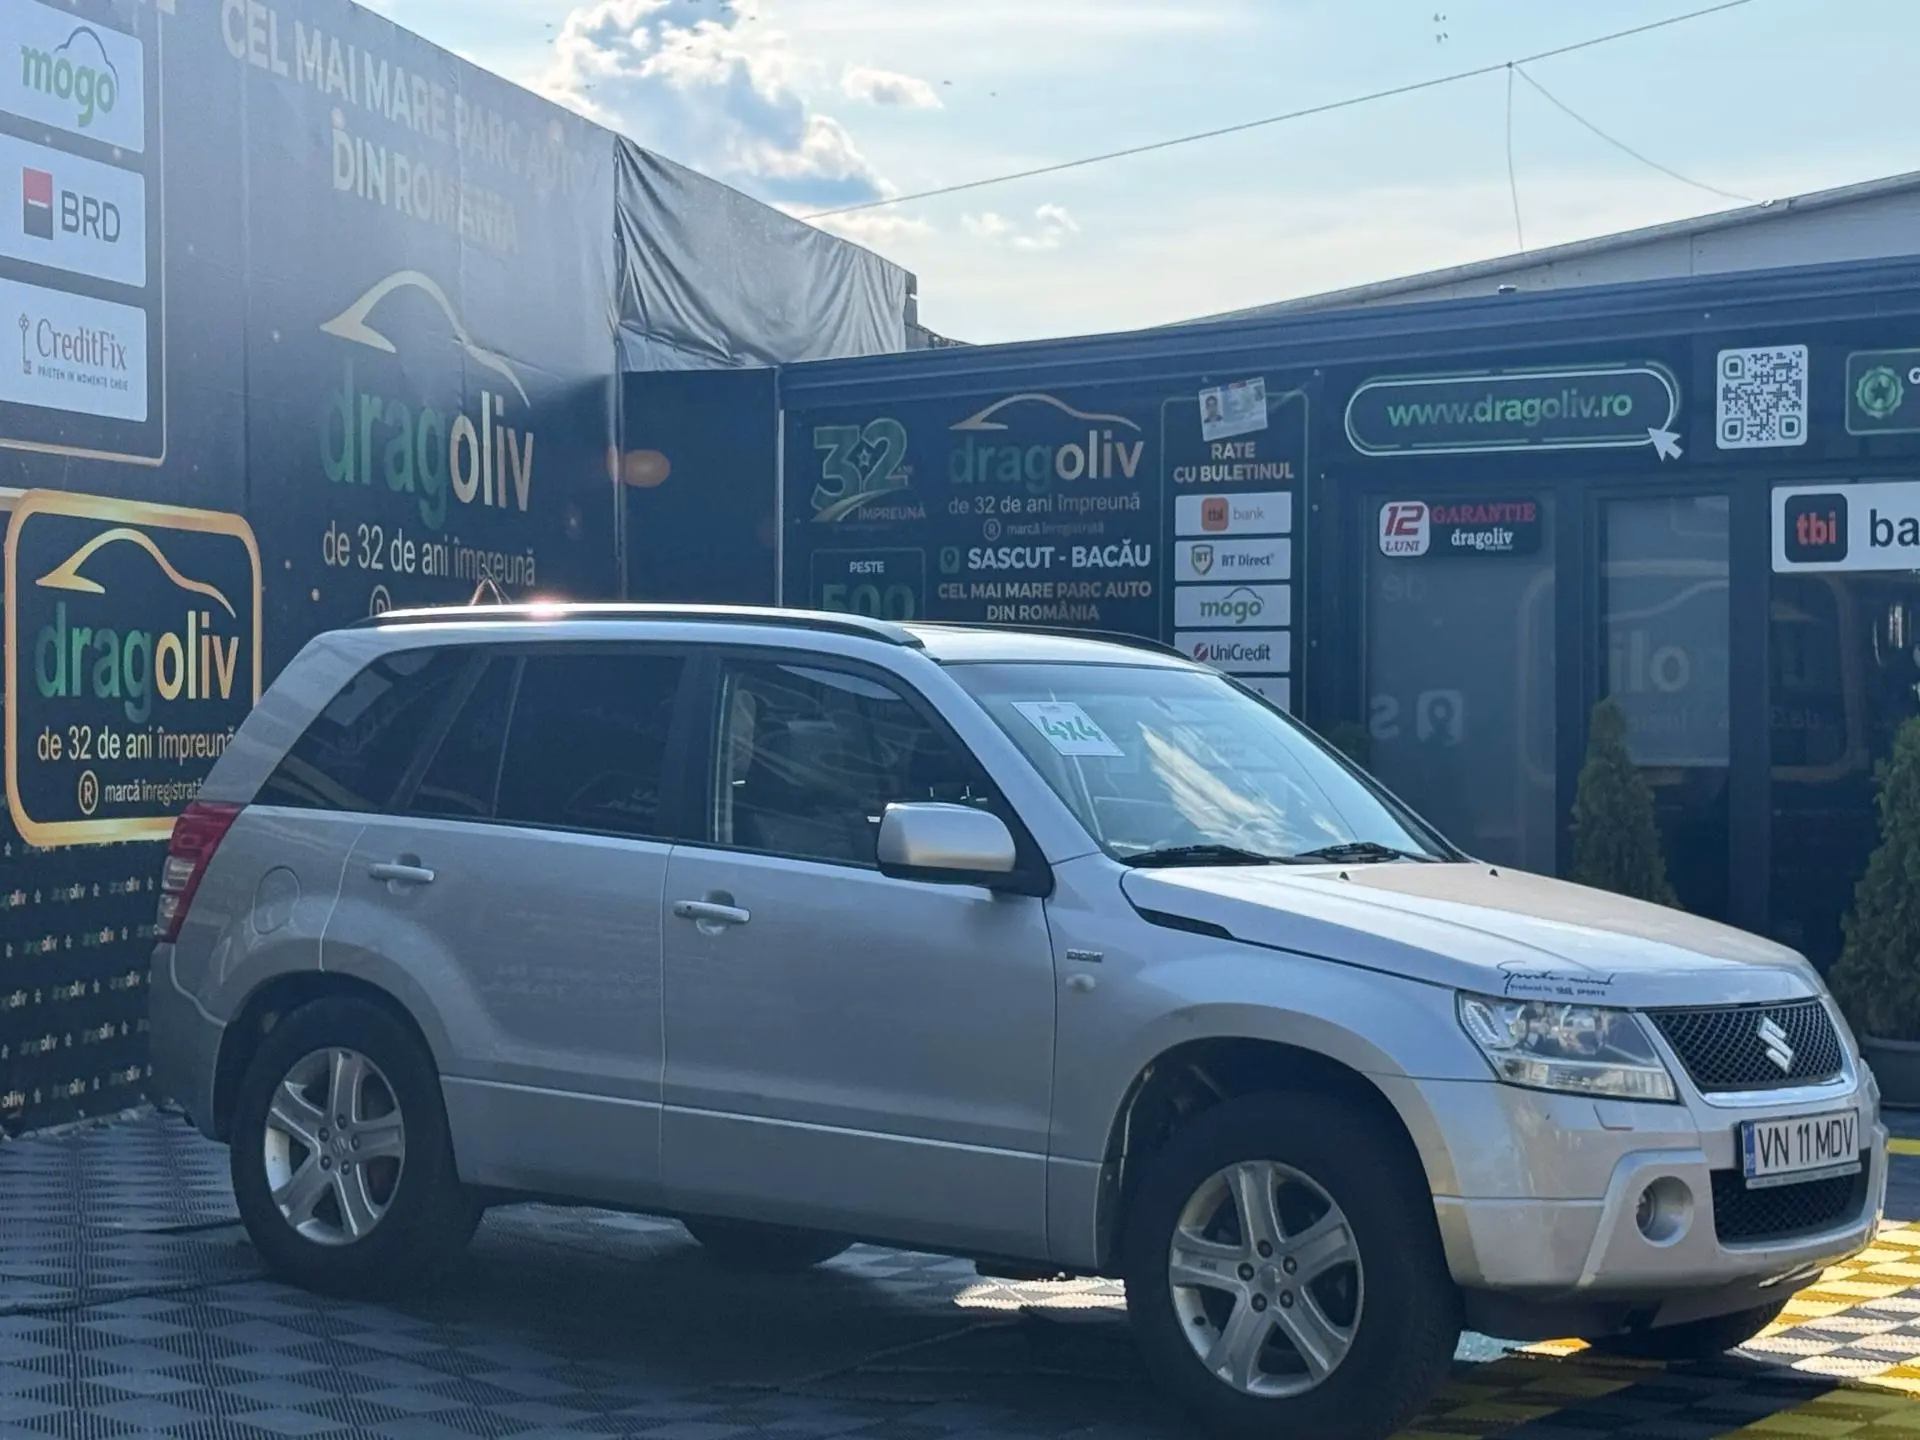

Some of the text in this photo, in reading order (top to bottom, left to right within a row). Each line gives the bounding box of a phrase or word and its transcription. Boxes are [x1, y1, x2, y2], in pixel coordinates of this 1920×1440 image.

[20, 44, 116, 128] mogo
[221, 0, 289, 77] CEL
[294, 20, 357, 104] MAI
[364, 50, 448, 143] MARE
[332, 126, 387, 205] DIN
[61, 190, 121, 243] BRD
[36, 318, 127, 371] CreditFix
[1387, 389, 1633, 427] www.dragoliv.ro
[319, 358, 534, 530] dragoliv
[1211, 442, 1255, 460] RATE
[950, 429, 1144, 494] dragoliv
[1174, 463, 1294, 483] CU BULETINUL
[948, 492, 1140, 516] de 32 de ani împreună
[1233, 507, 1264, 520] bank
[1431, 503, 1536, 523] GARANTIE
[1384, 505, 1424, 536] 12
[1796, 511, 1836, 545] tbi
[323, 520, 350, 566] de
[357, 523, 384, 570] 32
[390, 528, 416, 574] de
[422, 534, 448, 577] ani
[967, 547, 1055, 569] SASCUT
[1071, 539, 1151, 568] BACĂU
[1385, 541, 1420, 552] LUNI
[1451, 528, 1513, 550] dragoliv
[849, 561, 884, 573] PESTE
[938, 581, 1152, 599] CEL MAI MARE PARC AUTO
[987, 600, 1099, 621] DIN ROMÂNIA
[1200, 599, 1262, 624] mogo
[36, 601, 239, 724] dragoliv
[1211, 642, 1271, 662] UniCredit
[37, 726, 62, 760] de
[68, 724, 92, 760] 32
[97, 725, 120, 759] de
[126, 725, 152, 759] ani
[104, 778, 140, 803] marcă
[141, 778, 203, 807] înregistrat
[1758, 1117, 1853, 1168] VN 11 MDV
